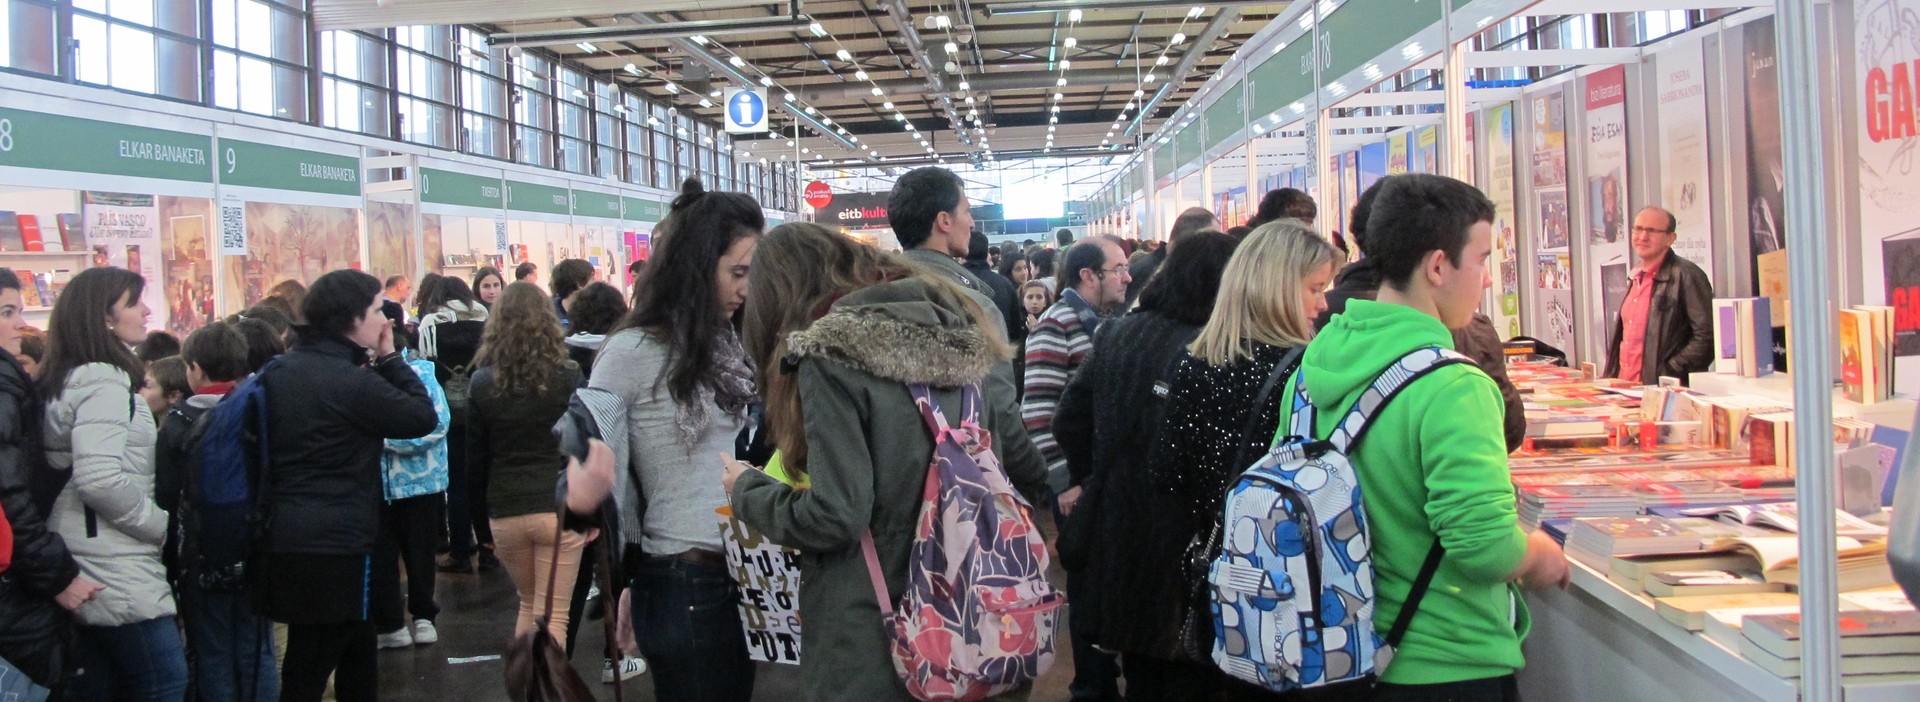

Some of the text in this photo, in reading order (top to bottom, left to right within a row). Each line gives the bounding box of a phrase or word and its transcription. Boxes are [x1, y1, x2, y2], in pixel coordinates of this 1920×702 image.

[1865, 58, 1920, 143] GA
[0, 118, 13, 151] 8
[120, 139, 206, 166] ELKAR BANAKETA
[226, 147, 236, 174] 9
[300, 162, 356, 182] ELKAR BANAKETA
